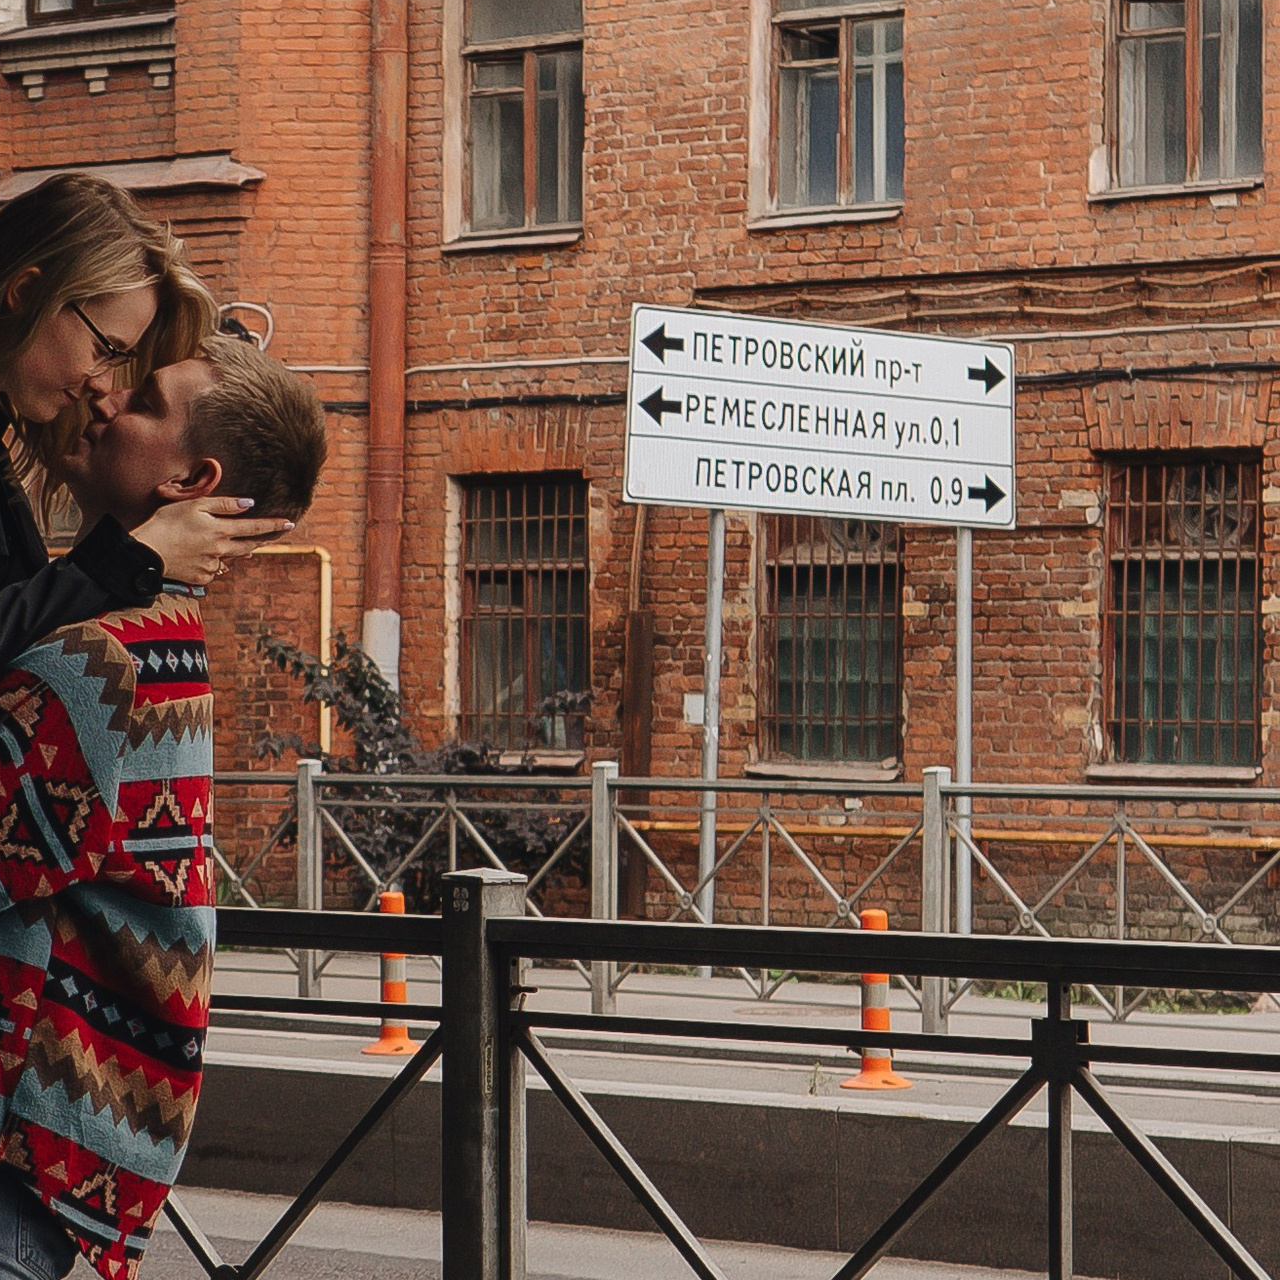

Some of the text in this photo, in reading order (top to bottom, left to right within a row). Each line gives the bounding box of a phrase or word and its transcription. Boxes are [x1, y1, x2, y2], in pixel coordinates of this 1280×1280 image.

[692, 331, 923, 388] ПЕТРОВСКИЙ пр-т
[684, 393, 887, 440] РЕМЕСЛЕННАЯ
[695, 457, 964, 507] ПЕТРОВСКАЯ пл. 0,9
